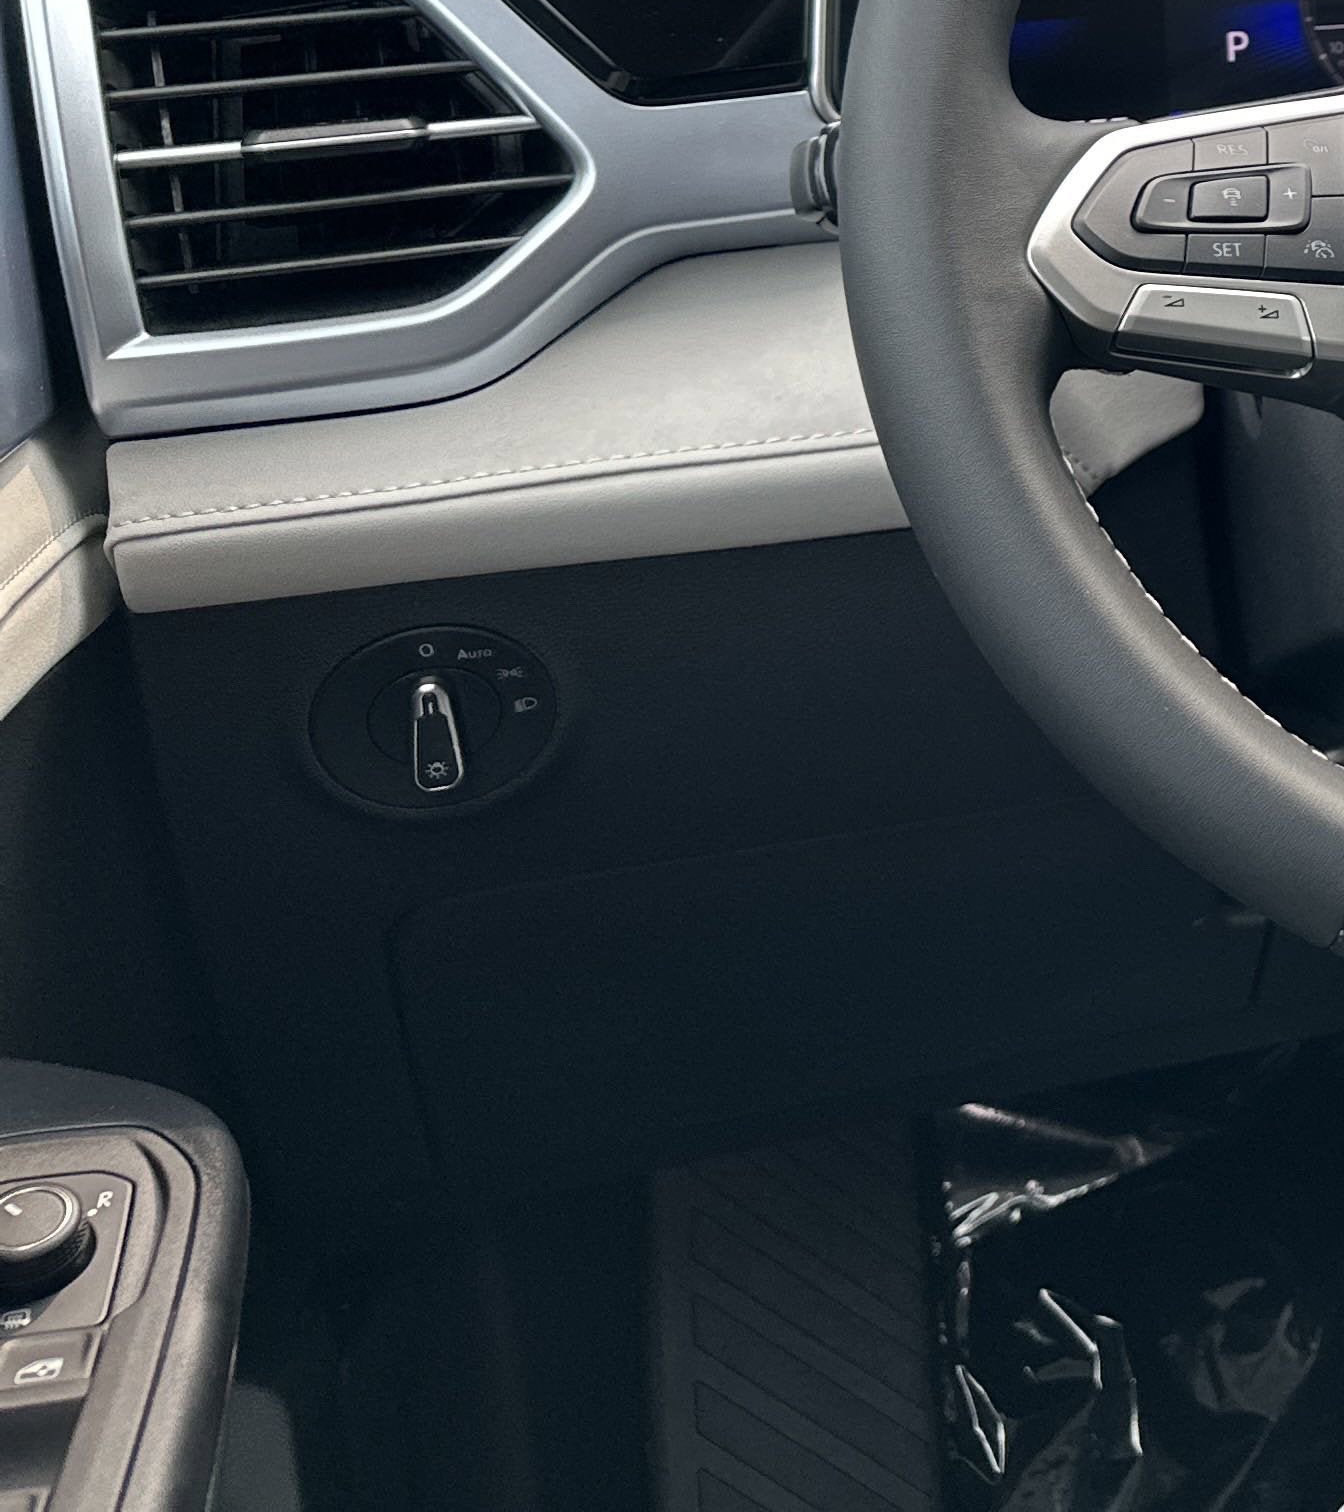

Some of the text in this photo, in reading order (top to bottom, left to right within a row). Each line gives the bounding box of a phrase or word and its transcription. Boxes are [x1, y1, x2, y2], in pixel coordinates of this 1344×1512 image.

[1225, 30, 1250, 63] P
[1216, 143, 1250, 158] RES
[1212, 242, 1243, 258] SET
[97, 1190, 115, 1209] R
